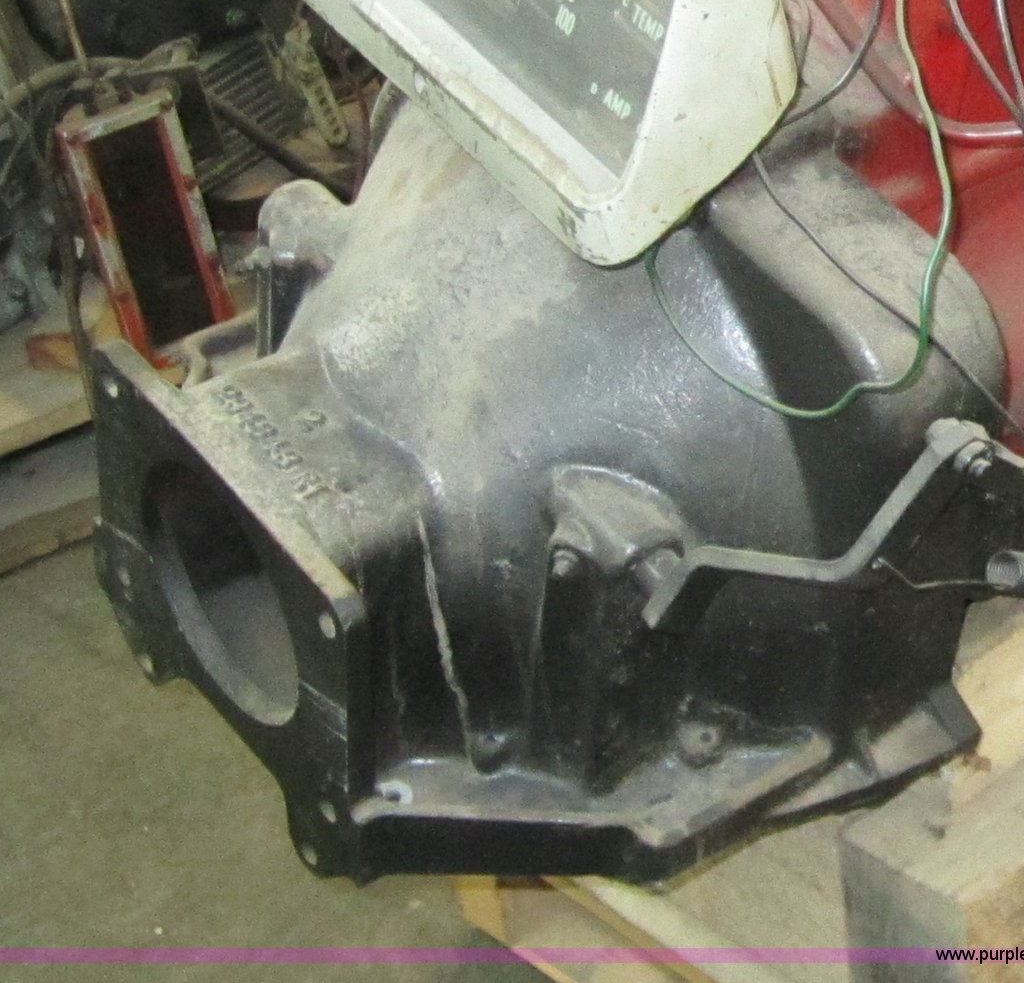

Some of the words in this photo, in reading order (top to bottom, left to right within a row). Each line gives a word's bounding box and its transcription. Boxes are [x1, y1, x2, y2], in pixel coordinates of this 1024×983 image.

[555, 4, 576, 36] 100
[632, 4, 665, 41] TEMP
[603, 88, 632, 120] AMP
